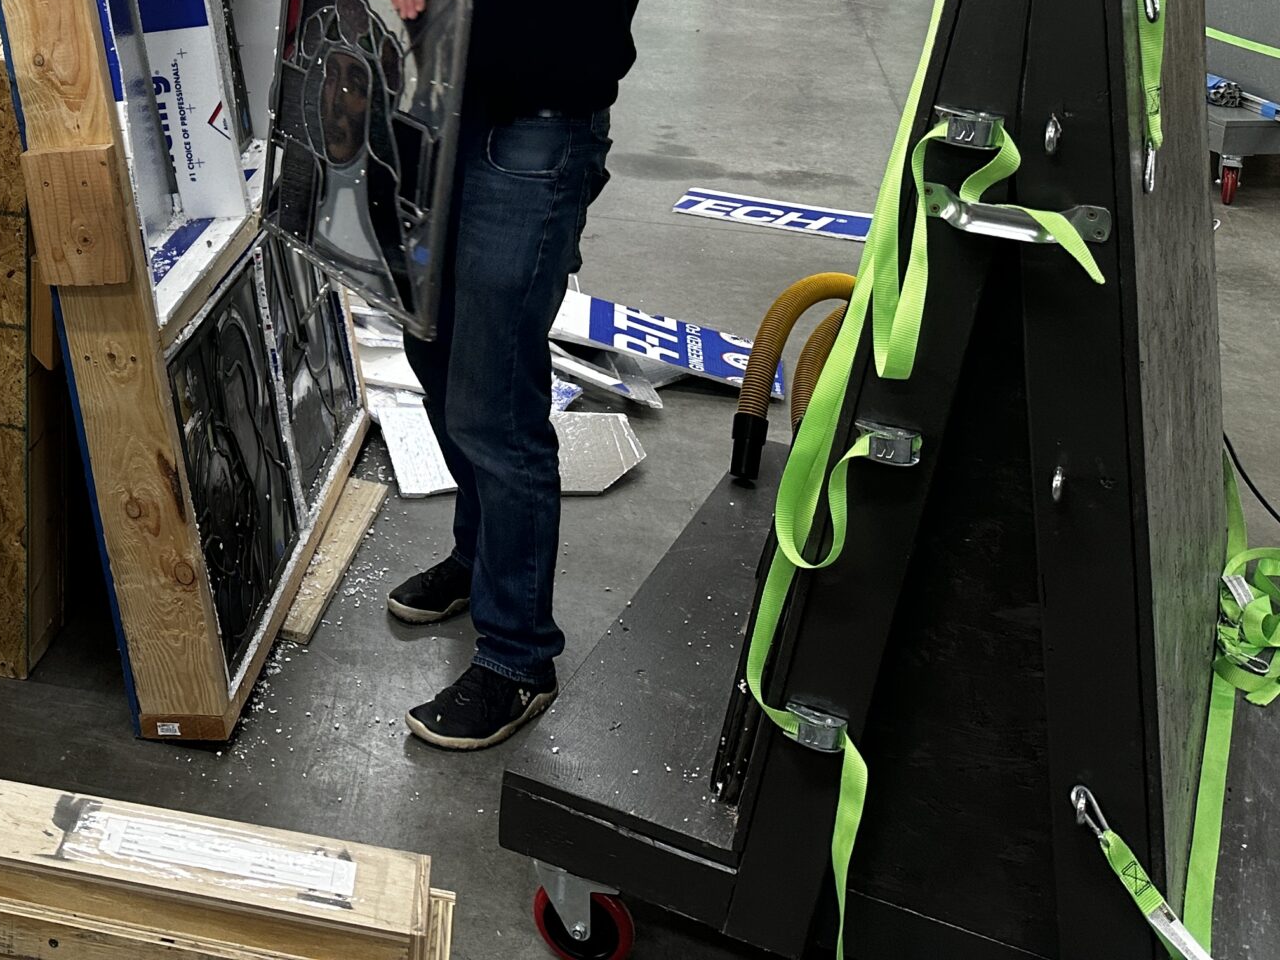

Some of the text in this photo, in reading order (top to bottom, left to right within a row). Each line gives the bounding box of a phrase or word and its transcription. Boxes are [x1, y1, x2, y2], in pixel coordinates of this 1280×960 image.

[171, 62, 188, 127] PROFESSIONALS
[182, 129, 190, 139] OF
[184, 141, 195, 170] CHOICE
